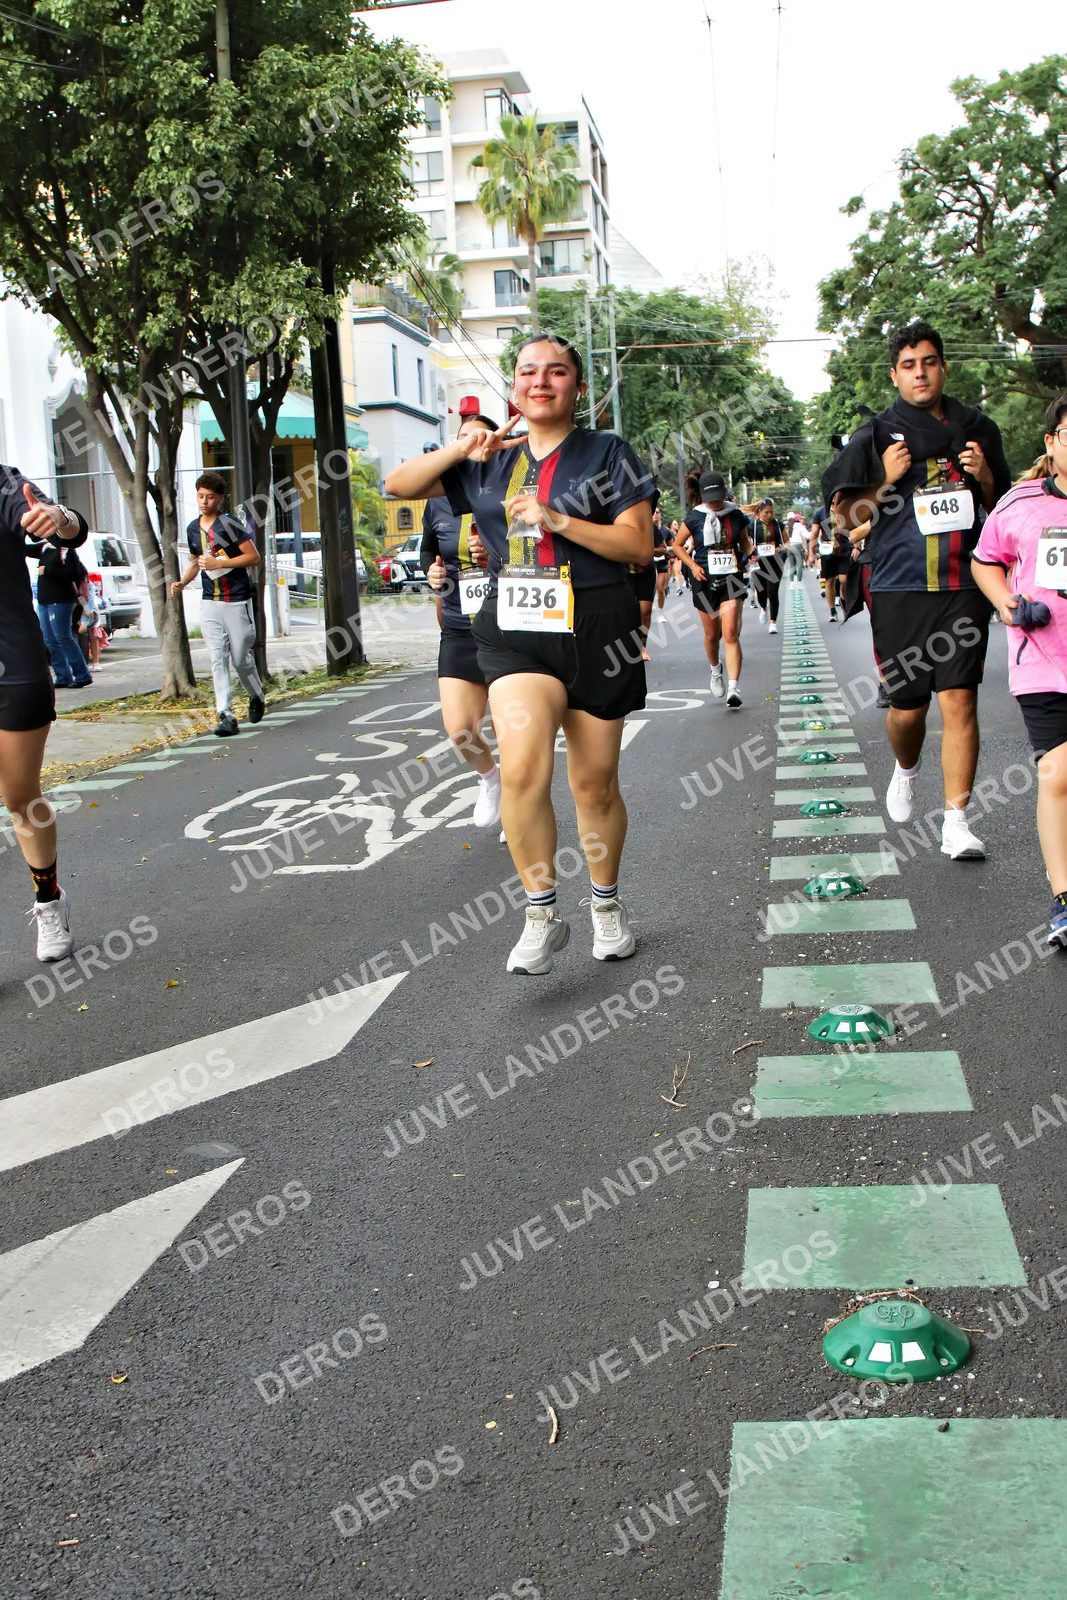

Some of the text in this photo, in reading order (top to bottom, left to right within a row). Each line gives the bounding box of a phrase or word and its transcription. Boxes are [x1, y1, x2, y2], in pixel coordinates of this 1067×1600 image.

[930, 498, 960, 516] 648
[712, 556, 732, 566] 3177
[1046, 546, 1067, 567] 61
[506, 586, 557, 609] 1236
